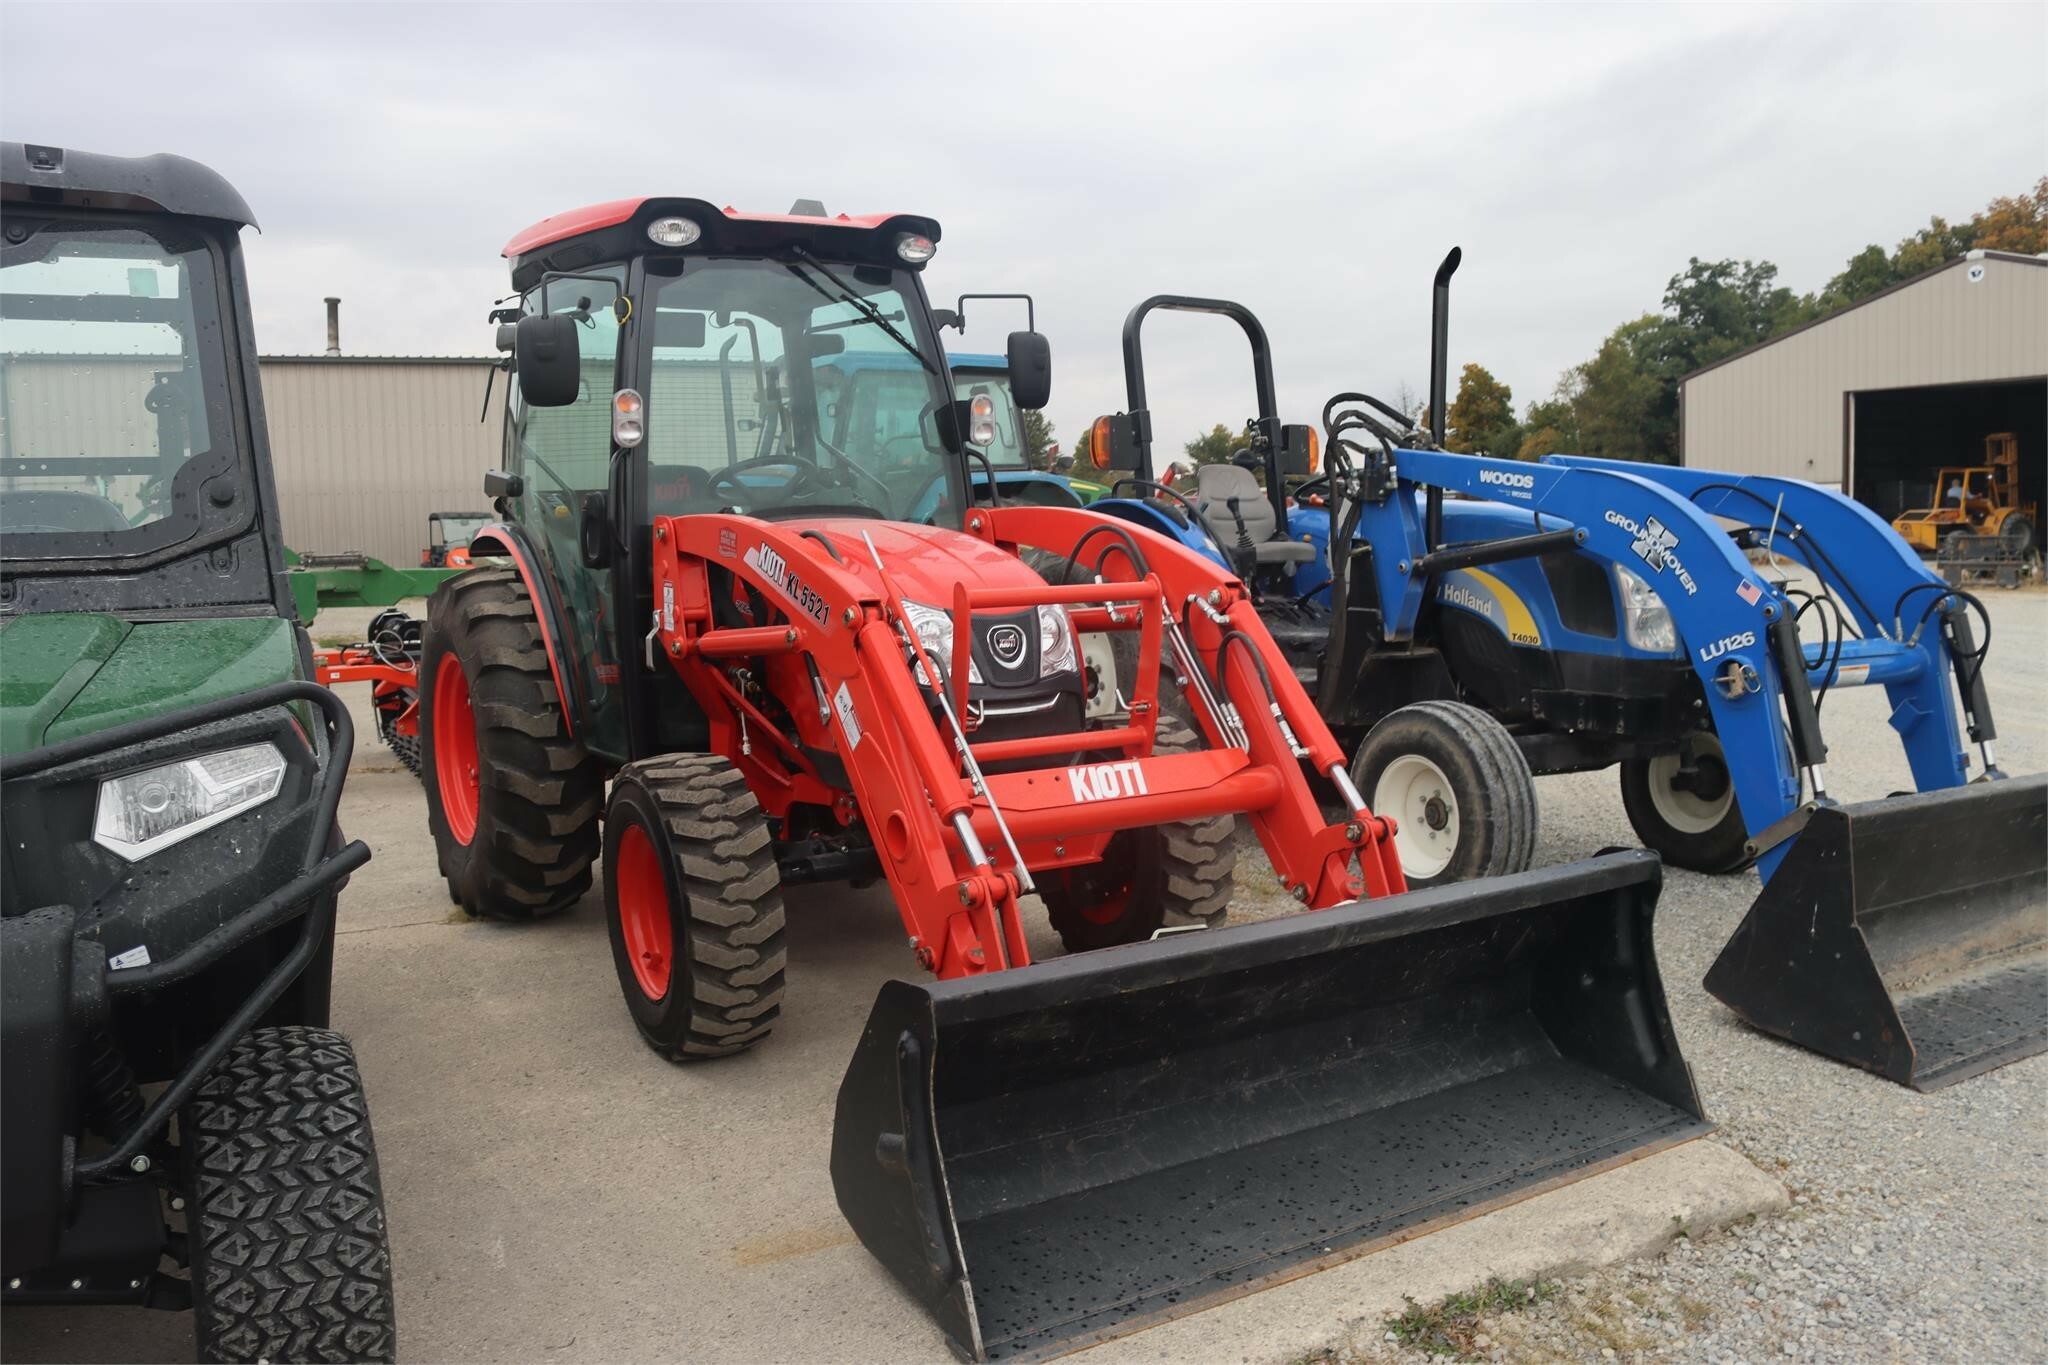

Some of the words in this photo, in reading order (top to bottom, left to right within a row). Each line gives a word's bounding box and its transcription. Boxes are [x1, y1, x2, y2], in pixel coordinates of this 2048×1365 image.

[1480, 470, 1534, 489] WOODS
[758, 541, 786, 587] KIOTI
[1604, 510, 1698, 596] GROUNDMOVER
[1444, 584, 1492, 617] Holland
[1511, 632, 1539, 644] T4030
[1700, 631, 1756, 662] LU126
[1067, 761, 1149, 803] KIOTI
